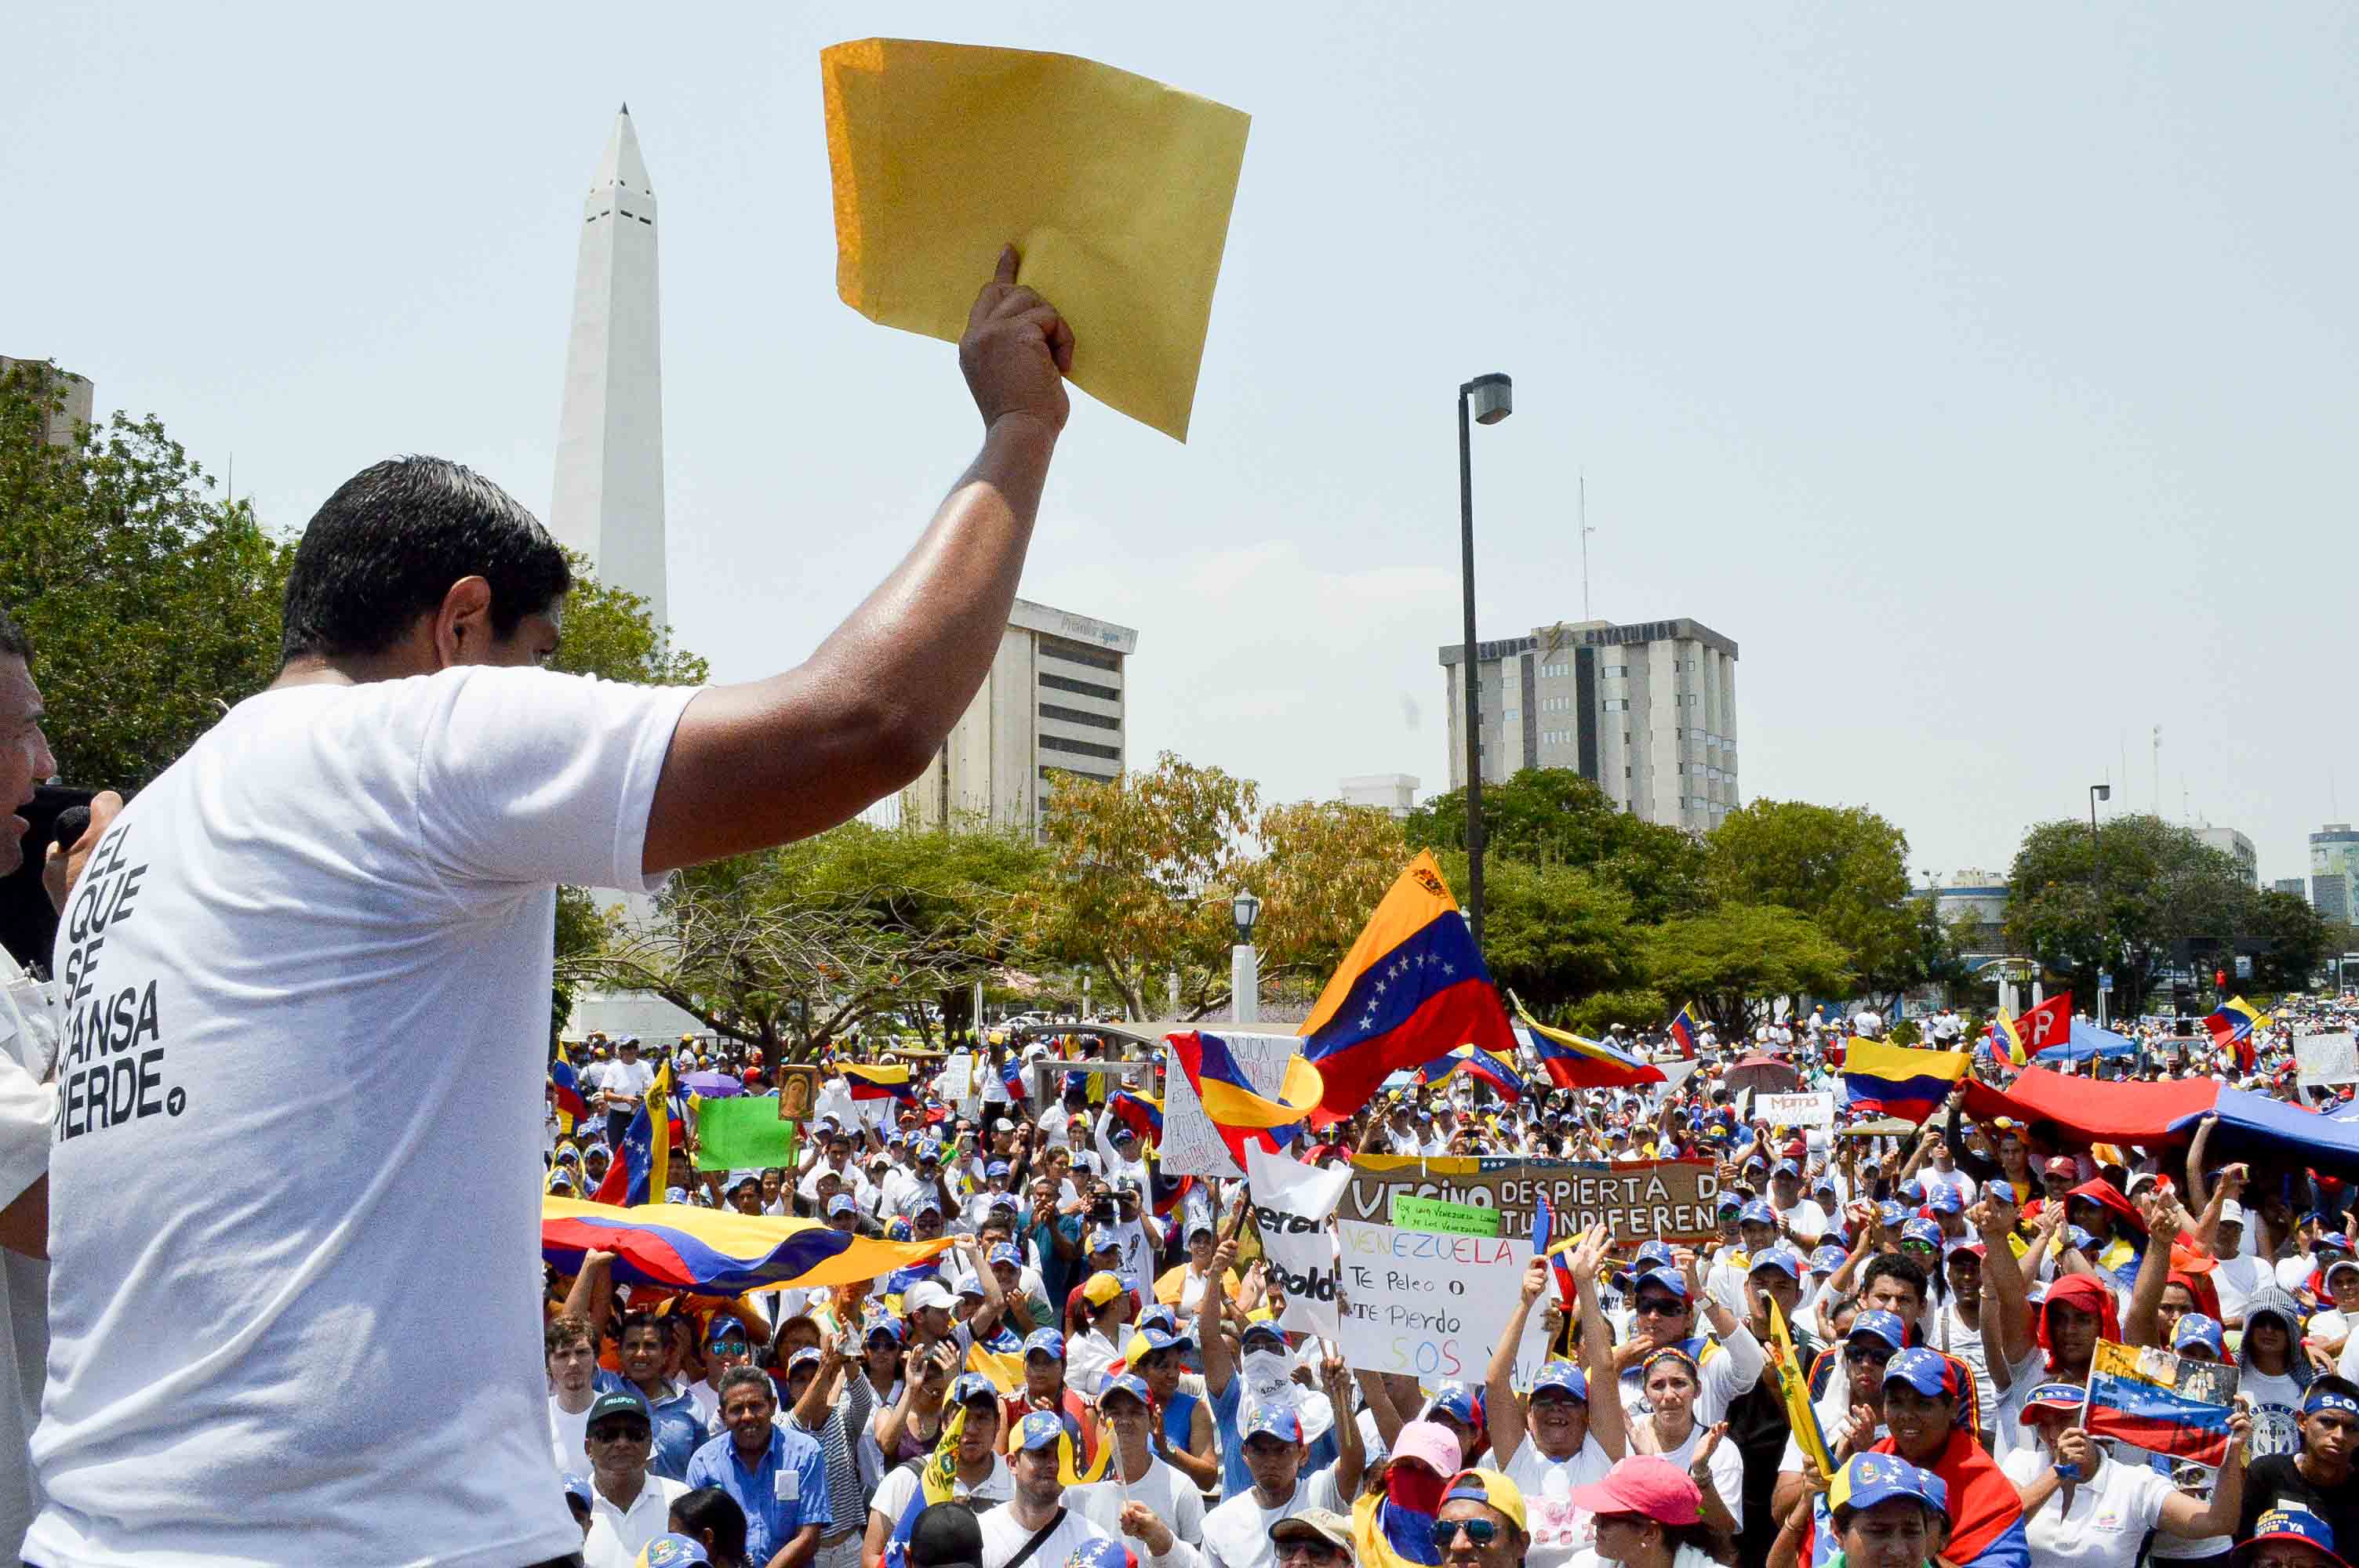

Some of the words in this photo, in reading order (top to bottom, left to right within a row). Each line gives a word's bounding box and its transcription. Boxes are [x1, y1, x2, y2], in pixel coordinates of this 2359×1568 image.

[85, 823, 132, 884] EL
[69, 863, 149, 944] QUE
[65, 936, 104, 1011] SE
[1697, 1174, 1717, 1200] D
[1550, 1204, 1714, 1237] INDIFEREN
[1344, 1229, 1513, 1266] VENEZUELA
[1349, 1266, 1375, 1290] TE
[1354, 1302, 1380, 1322] TE
[1391, 1336, 1462, 1377] SOS
